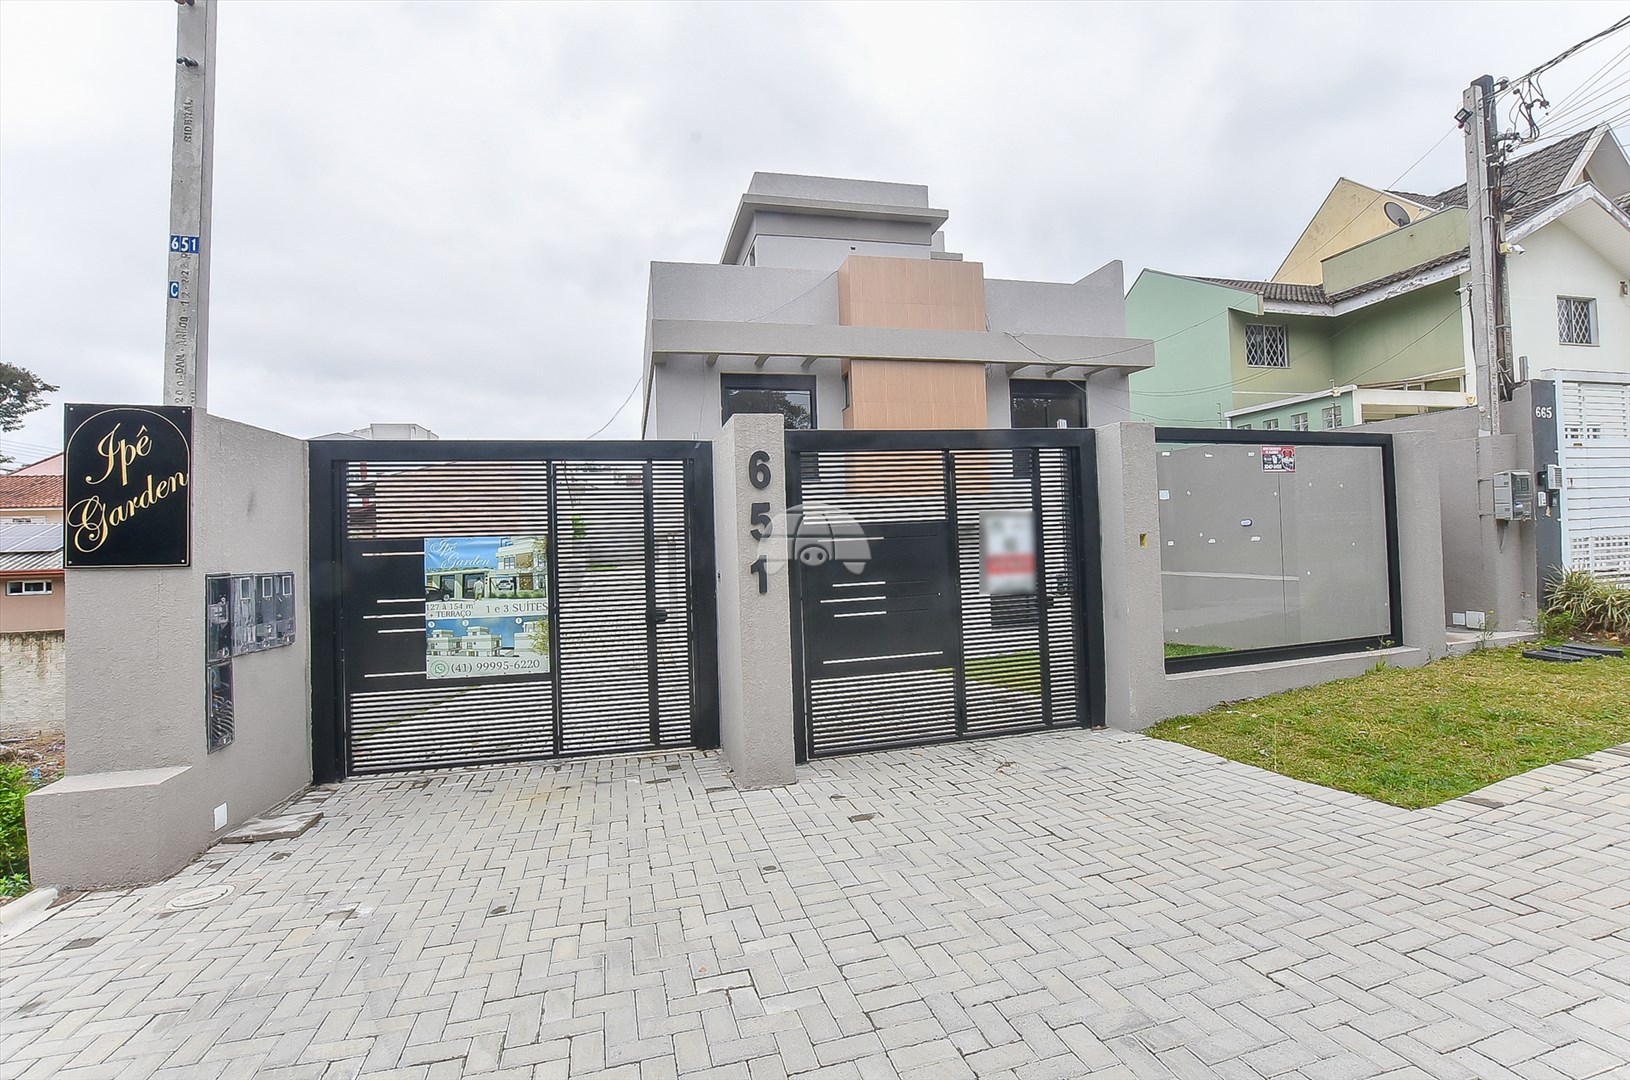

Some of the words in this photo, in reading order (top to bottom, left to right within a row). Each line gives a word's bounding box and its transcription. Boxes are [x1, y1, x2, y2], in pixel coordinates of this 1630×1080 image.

[171, 237, 196, 252] 651
[170, 282, 179, 297] C
[1535, 406, 1553, 418] 665
[85, 422, 152, 486] Ipê
[67, 471, 189, 553] Garden
[441, 553, 490, 569] Garden
[426, 602, 439, 611] 127
[449, 602, 463, 610] 154
[436, 609, 472, 618] TERRAÇO
[503, 605, 509, 613] 3
[451, 663, 473, 674] (41)
[476, 659, 540, 671] 99995-6220
